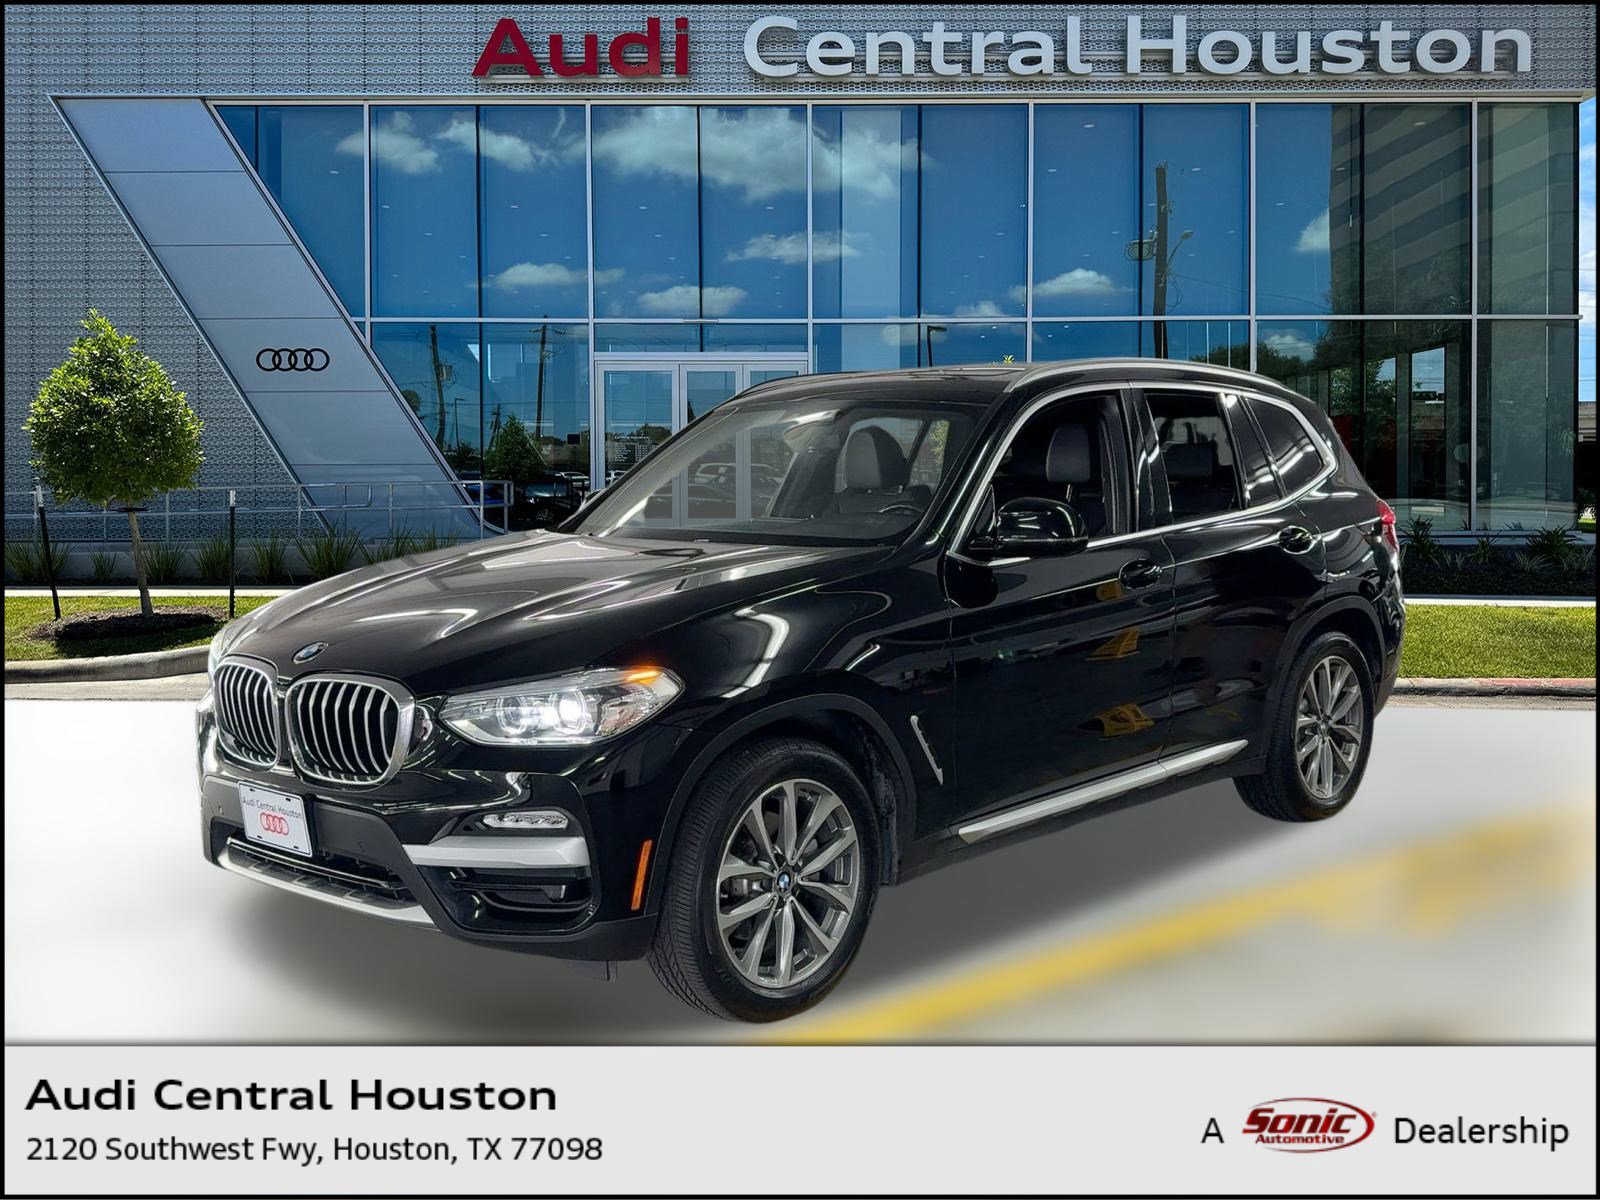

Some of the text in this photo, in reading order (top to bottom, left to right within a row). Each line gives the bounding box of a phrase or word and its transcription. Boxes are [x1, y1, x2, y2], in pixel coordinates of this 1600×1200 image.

[474, 14, 1532, 77] Audi Central Houston
[257, 799, 277, 813] Central
[278, 804, 304, 820] Houston
